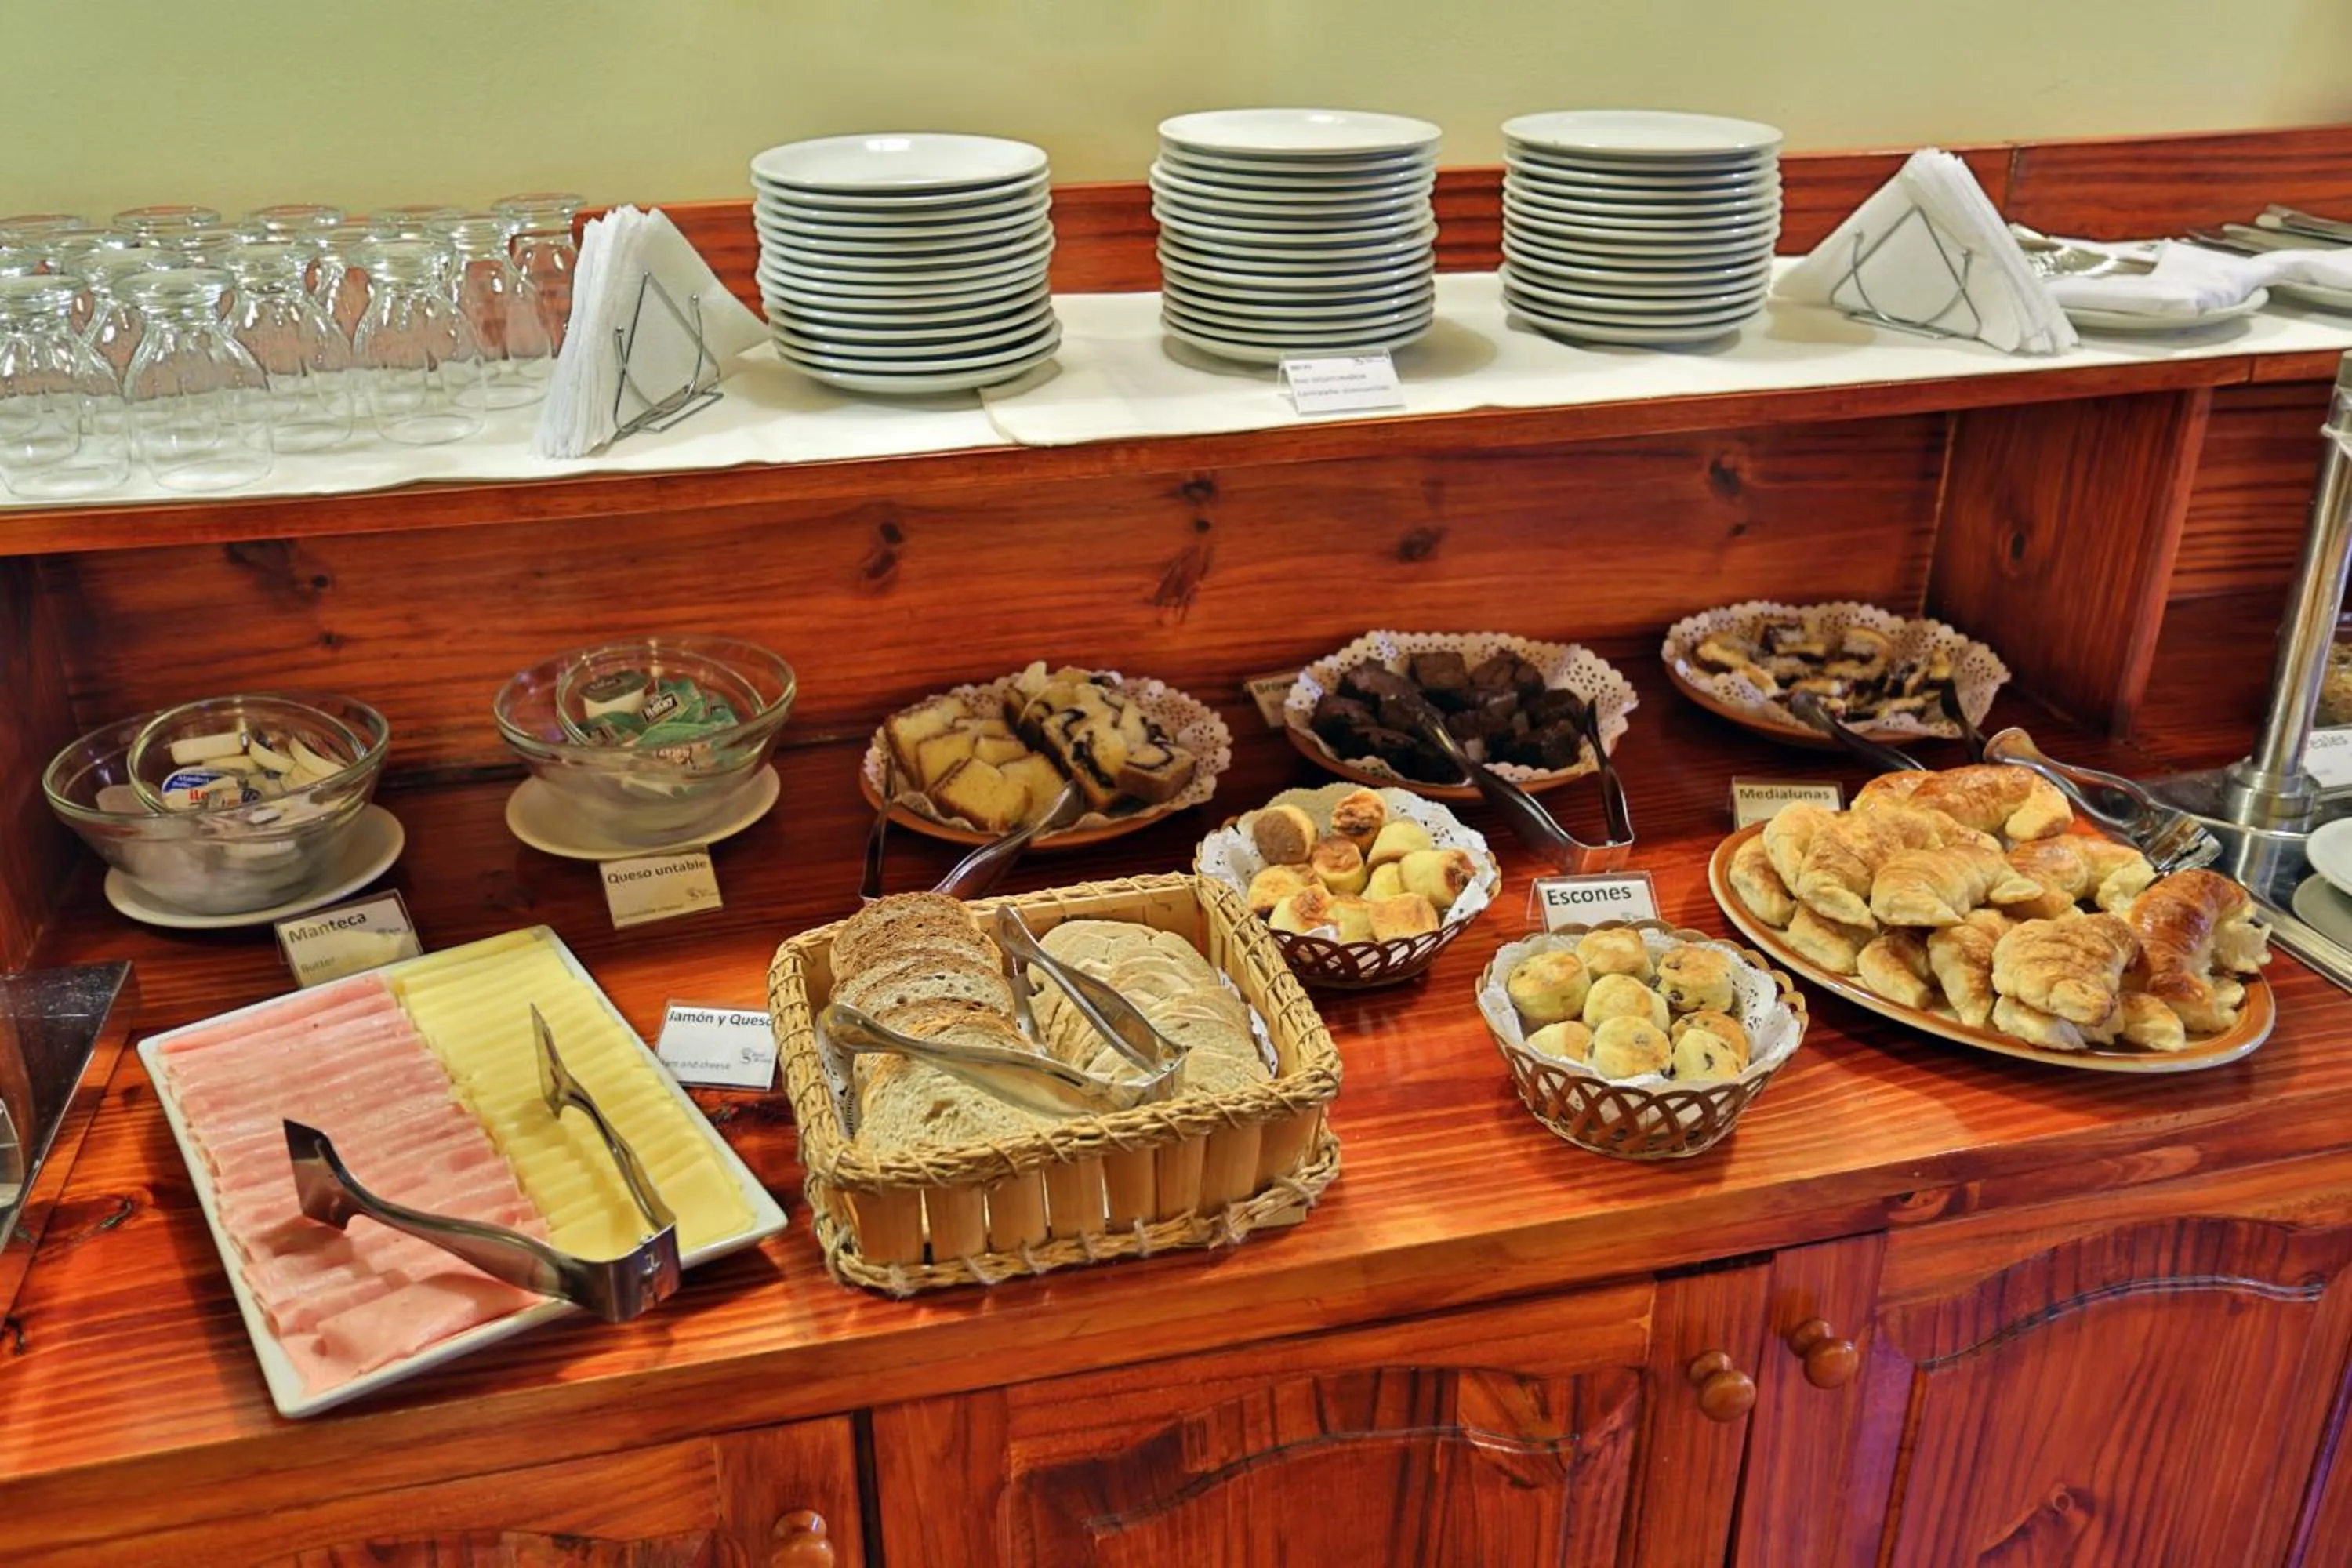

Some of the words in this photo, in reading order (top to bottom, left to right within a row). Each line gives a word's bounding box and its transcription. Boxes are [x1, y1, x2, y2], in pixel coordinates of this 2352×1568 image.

[1739, 788, 1831, 800] Medialunas
[608, 869, 652, 885] Queso
[655, 859, 708, 877] untable
[1546, 886, 1632, 906] Escones
[288, 913, 368, 943] Manteca
[669, 1010, 714, 1024] Jamón
[717, 1015, 726, 1026] y
